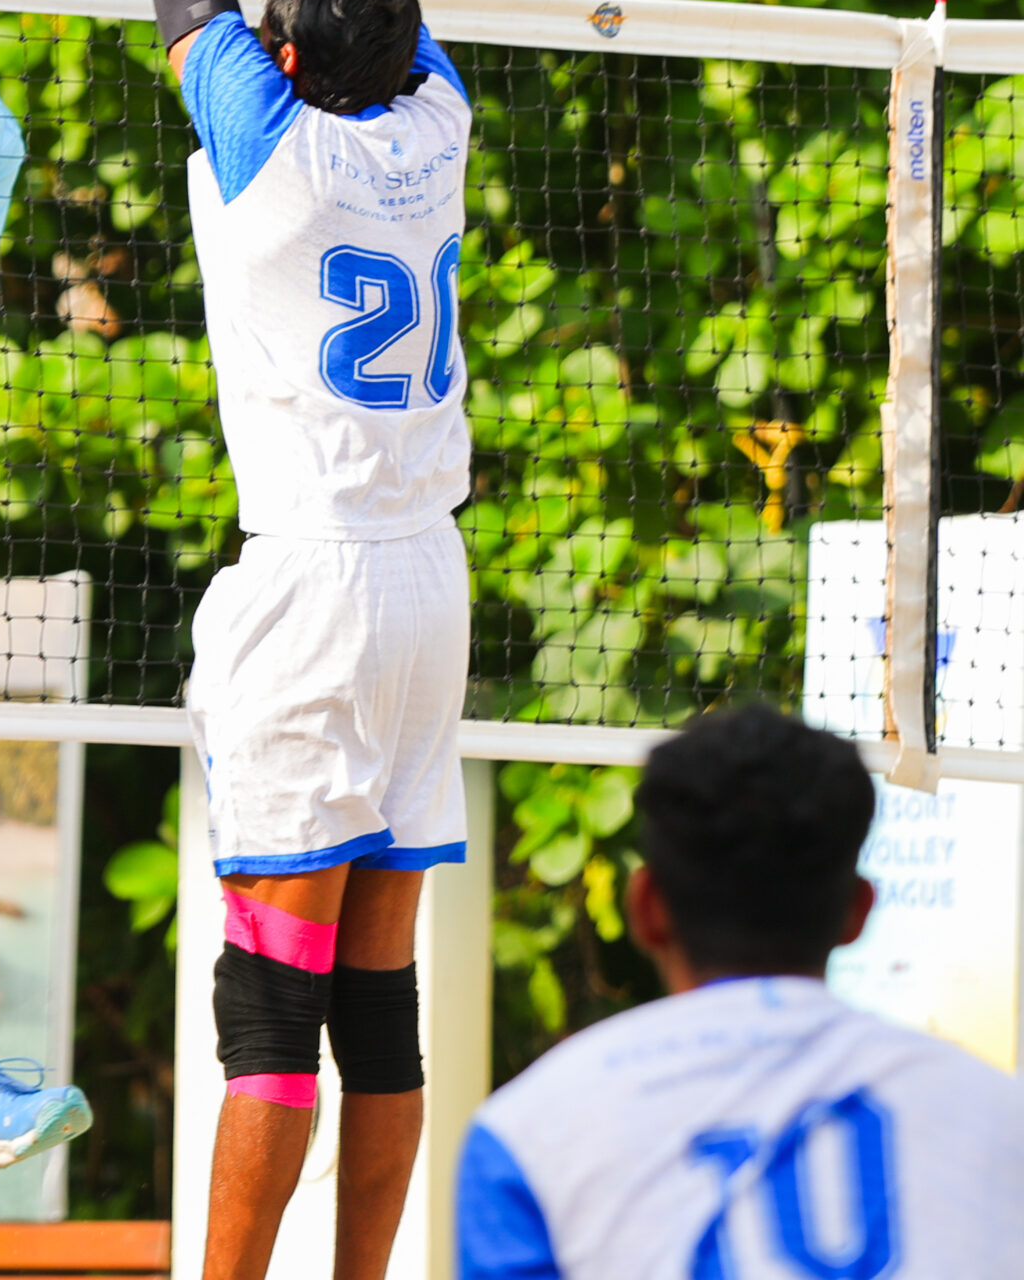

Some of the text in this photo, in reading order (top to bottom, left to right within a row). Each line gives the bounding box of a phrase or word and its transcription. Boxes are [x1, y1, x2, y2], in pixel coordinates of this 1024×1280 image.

[378, 193, 425, 207] RESOR
[875, 791, 957, 822] ESORT
[874, 877, 957, 909] EAGUE
